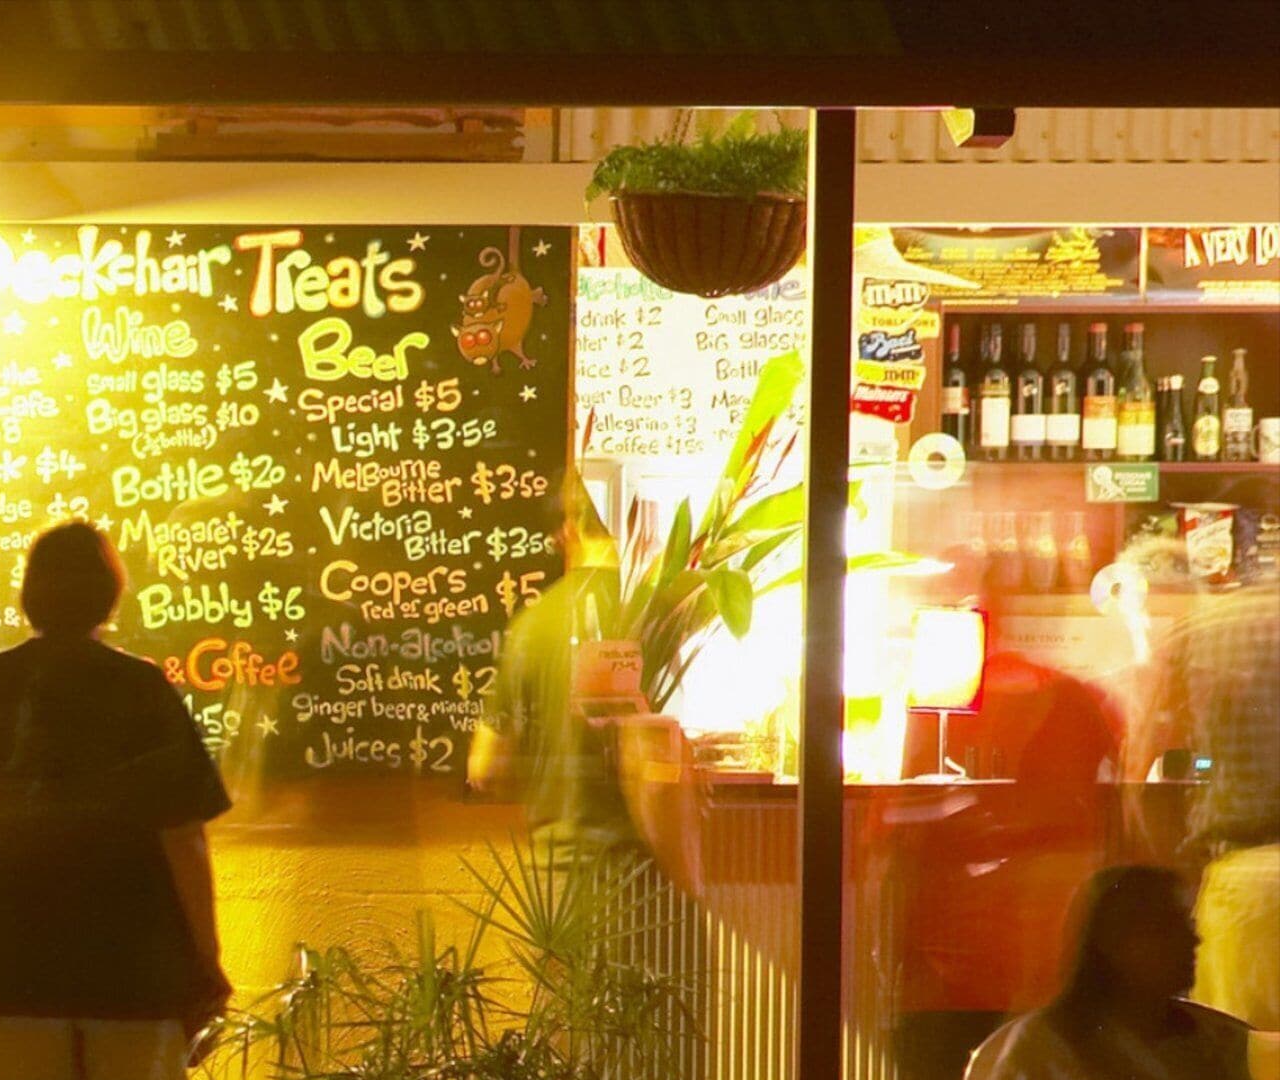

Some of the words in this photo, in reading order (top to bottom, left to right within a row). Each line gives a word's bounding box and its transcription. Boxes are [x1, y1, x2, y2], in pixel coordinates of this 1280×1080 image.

[1185, 231, 1201, 269] A
[1201, 226, 1250, 267] VERY
[235, 229, 426, 318] Treats
[81, 305, 197, 361] Wine
[581, 309, 626, 328] drink
[637, 305, 662, 327] $2
[705, 303, 746, 326] Small
[754, 304, 804, 328] glass
[298, 316, 430, 381] Beer
[616, 330, 644, 351] $2
[141, 363, 206, 402] glass
[216, 361, 259, 395] $5
[619, 357, 651, 378] $2
[298, 385, 404, 424] Special
[415, 378, 462, 412] $5
[619, 384, 662, 408] Beer
[86, 398, 138, 438] Big
[141, 401, 208, 433] glass
[216, 401, 260, 431] $10
[331, 421, 402, 457] Light
[601, 435, 660, 456] Coffee
[35, 446, 87, 484] $4
[112, 458, 228, 507] Bottle
[229, 452, 286, 492] $20
[381, 478, 461, 507] Bitter
[119, 509, 244, 554] Margaret
[320, 506, 432, 545] Victoria
[405, 529, 482, 560] Bitter
[158, 544, 238, 580] River
[242, 527, 294, 561] $25
[320, 560, 467, 604] Coopers
[495, 570, 546, 619] $5
[3, 605, 20, 628] &
[137, 581, 252, 629] Bubbly
[258, 581, 305, 620] $6
[361, 599, 394, 620] red
[424, 593, 488, 624] green
[163, 655, 186, 686] &
[186, 638, 301, 691] Coffee
[336, 664, 384, 695] Soft
[388, 666, 443, 695] drink
[452, 663, 498, 699] $2
[370, 696, 417, 720] beer
[305, 726, 400, 768] Juices
[409, 726, 453, 775] $2
